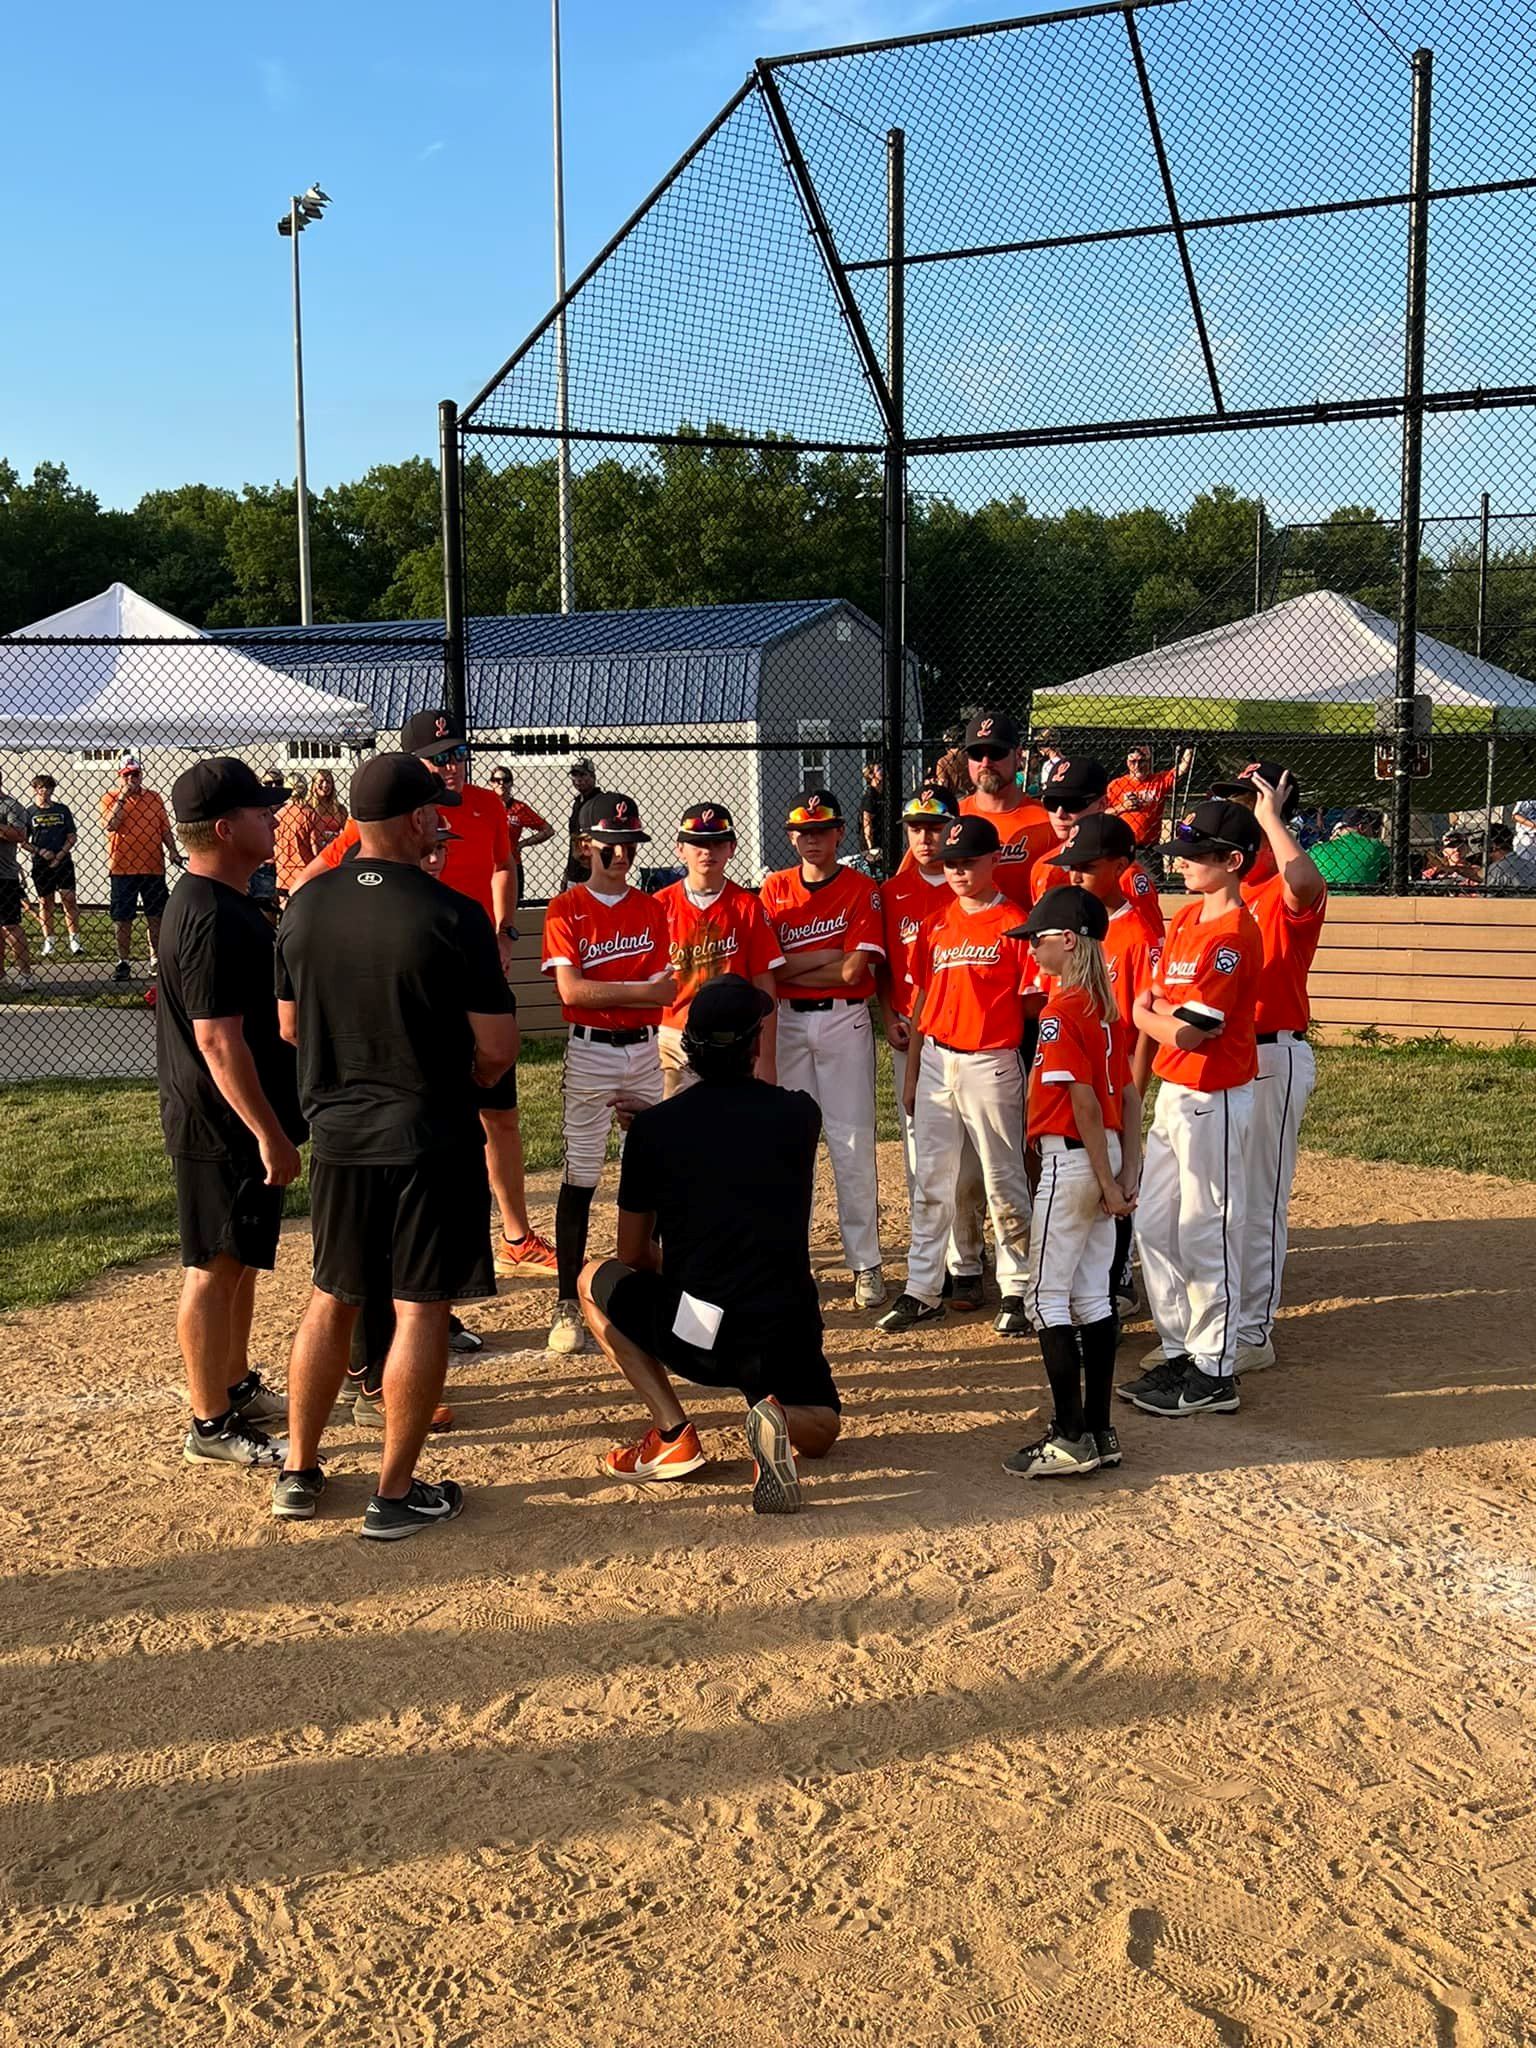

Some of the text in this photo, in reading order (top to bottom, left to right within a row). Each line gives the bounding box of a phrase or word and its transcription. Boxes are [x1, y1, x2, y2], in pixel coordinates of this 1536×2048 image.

[976, 718, 994, 738] L
[1052, 761, 1071, 782] L
[946, 824, 963, 846] L
[778, 908, 848, 951] Loveland
[578, 927, 655, 969] Loveland
